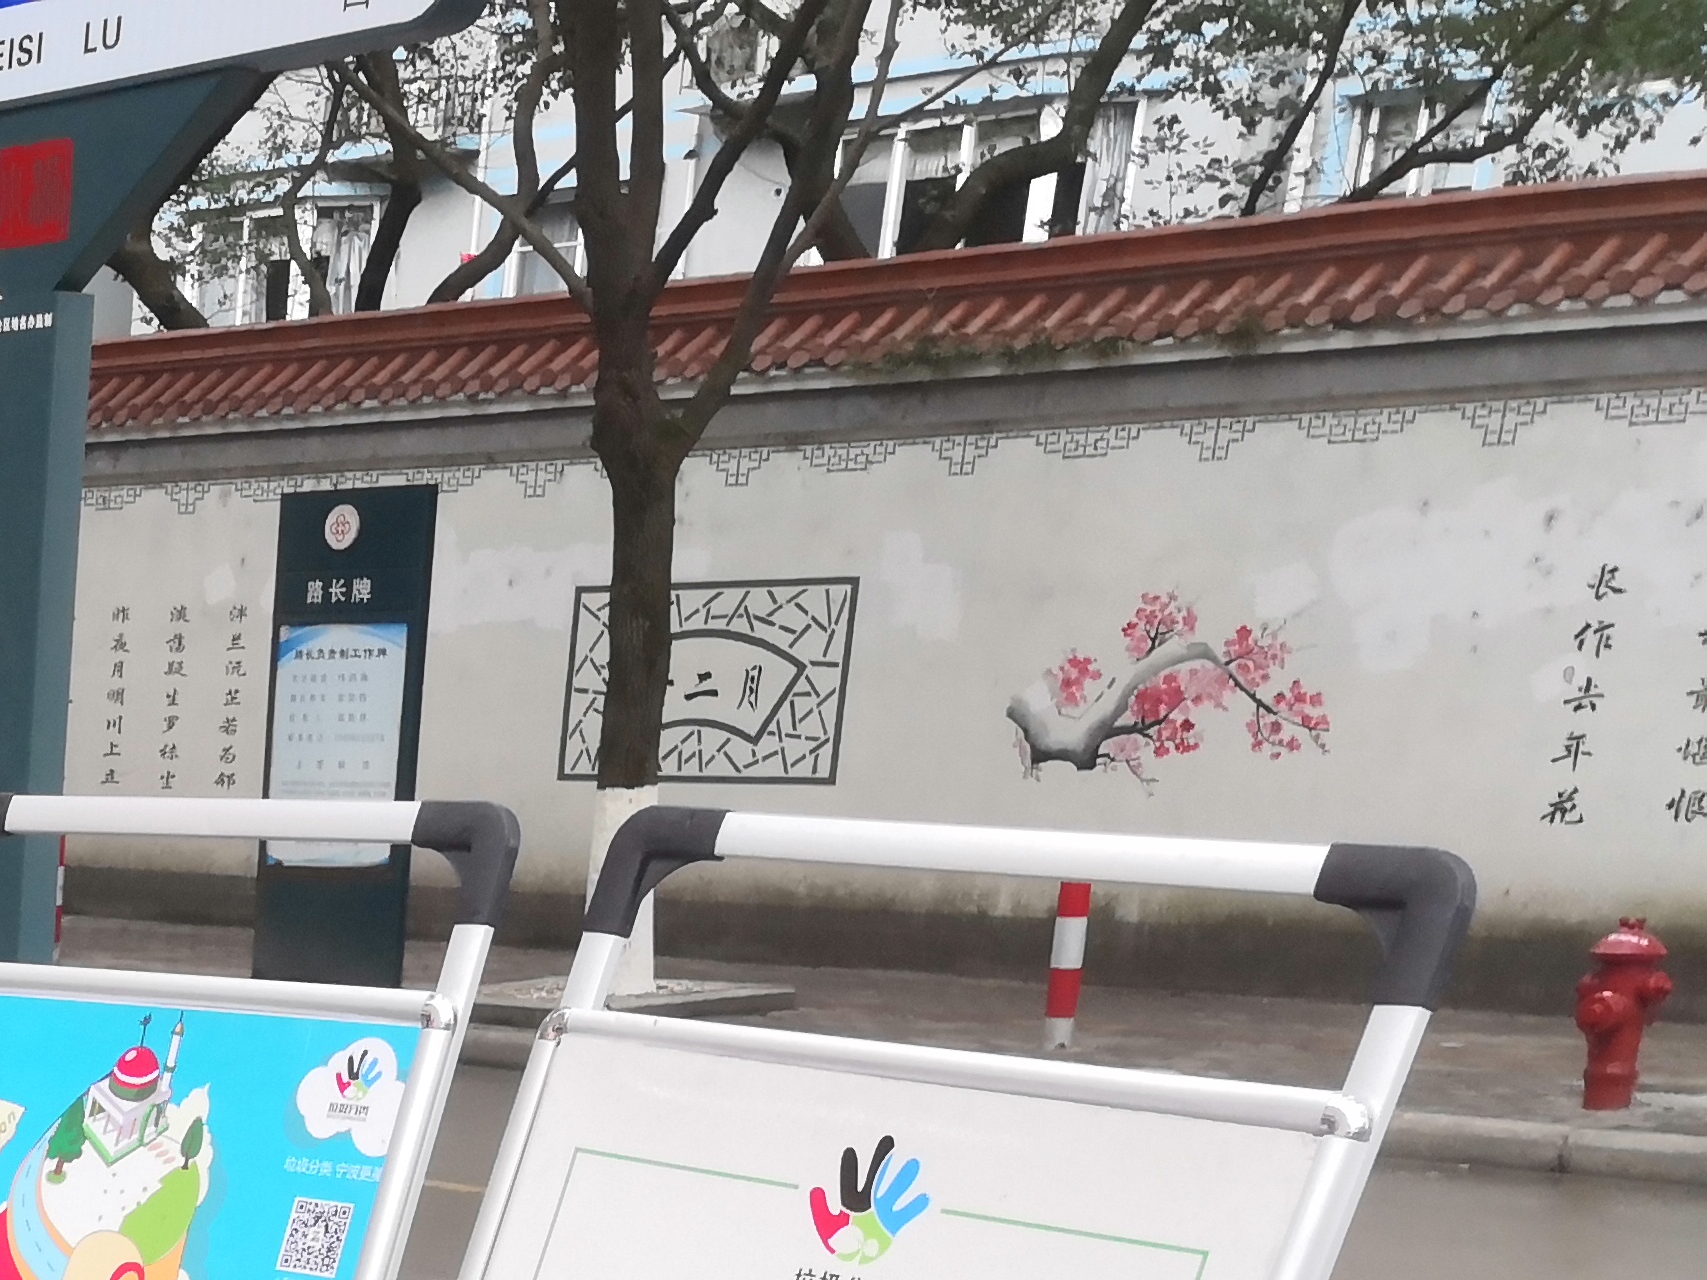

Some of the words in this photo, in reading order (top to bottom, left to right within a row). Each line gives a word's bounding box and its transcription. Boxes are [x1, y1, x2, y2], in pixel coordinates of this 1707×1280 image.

[82, 16, 122, 55] LU
[306, 576, 372, 605] 路长牌
